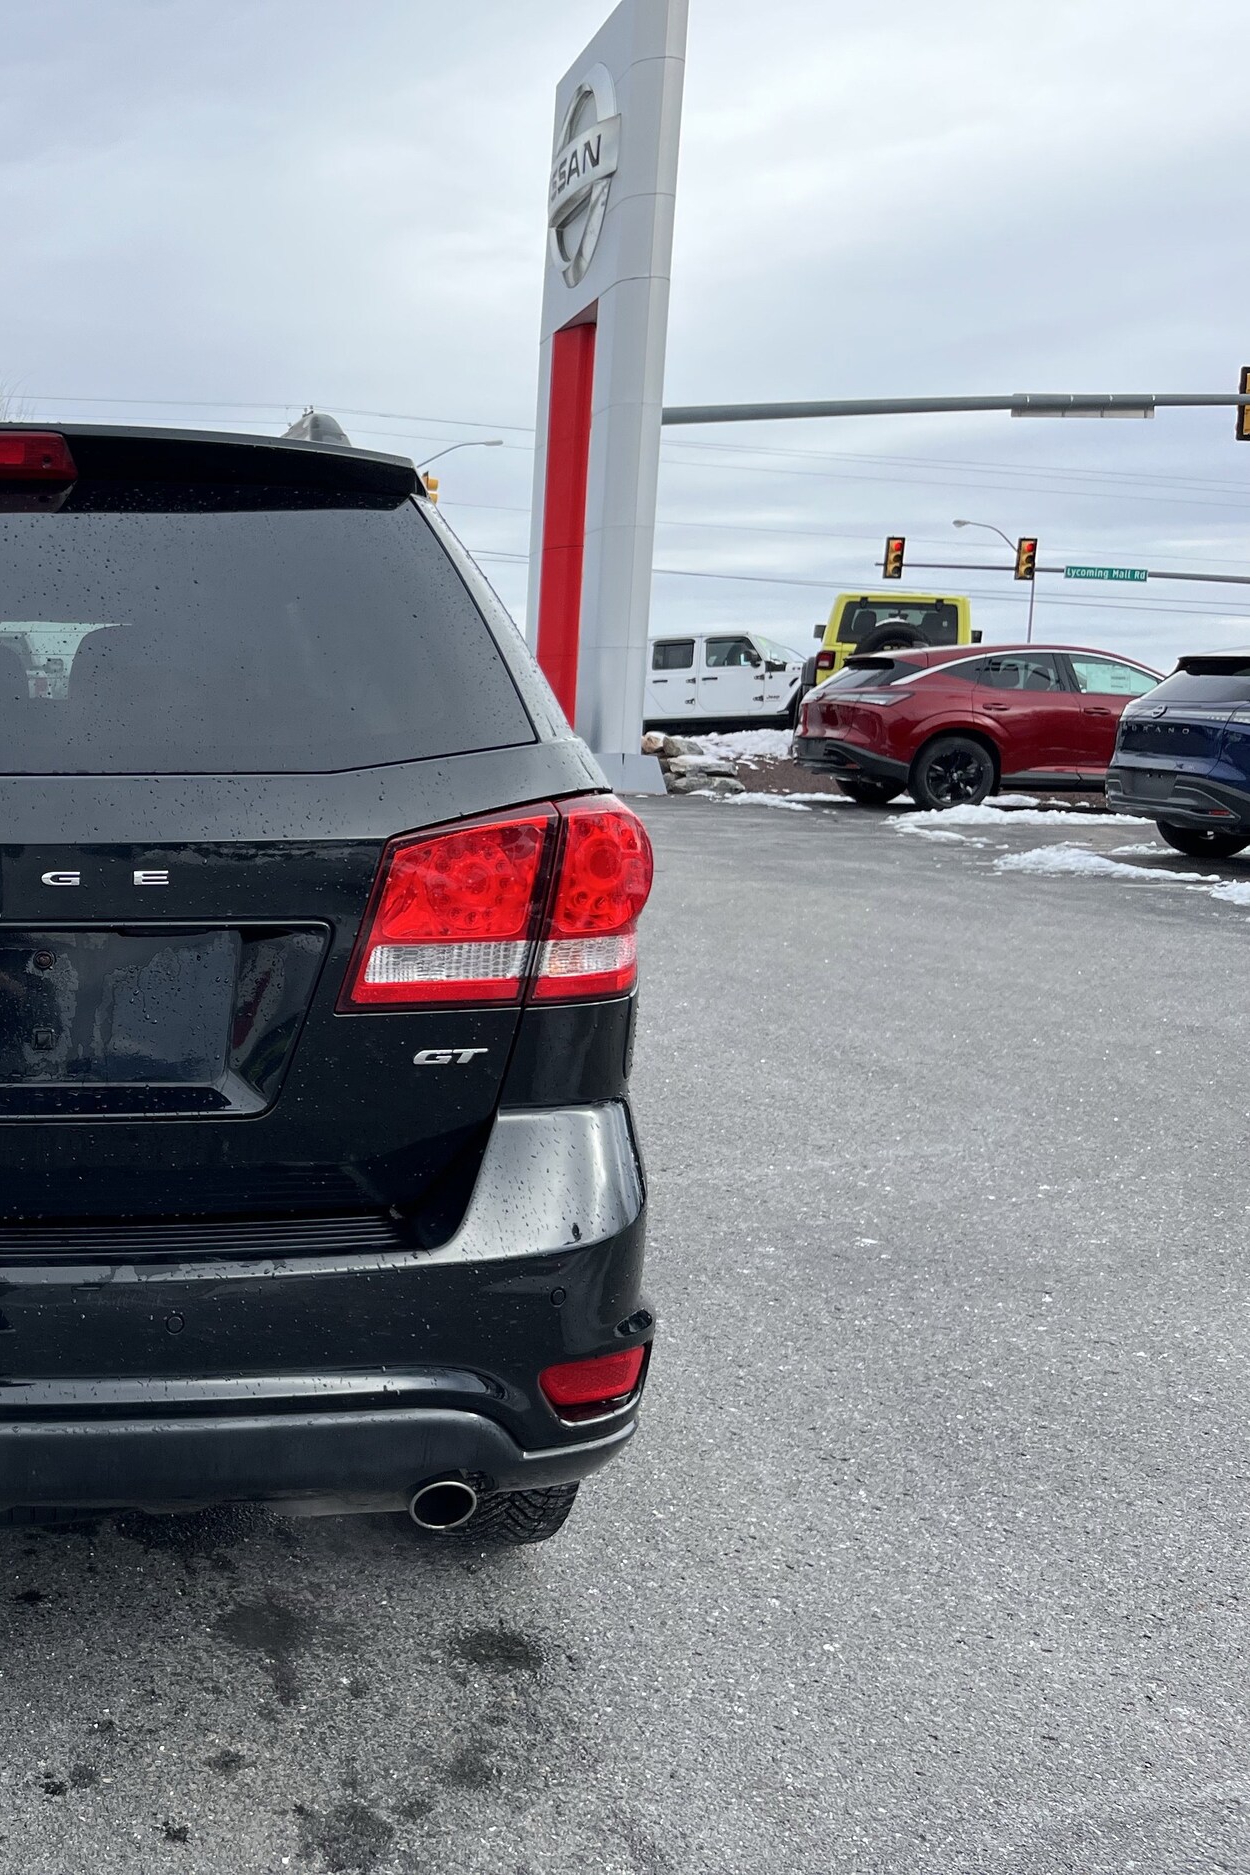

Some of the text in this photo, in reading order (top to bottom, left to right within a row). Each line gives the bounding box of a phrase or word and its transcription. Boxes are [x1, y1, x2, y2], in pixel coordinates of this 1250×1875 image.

[551, 133, 602, 203] SSAN
[1067, 567, 1146, 580] Lycoming Mall Rd
[412, 1047, 489, 1065] GT
